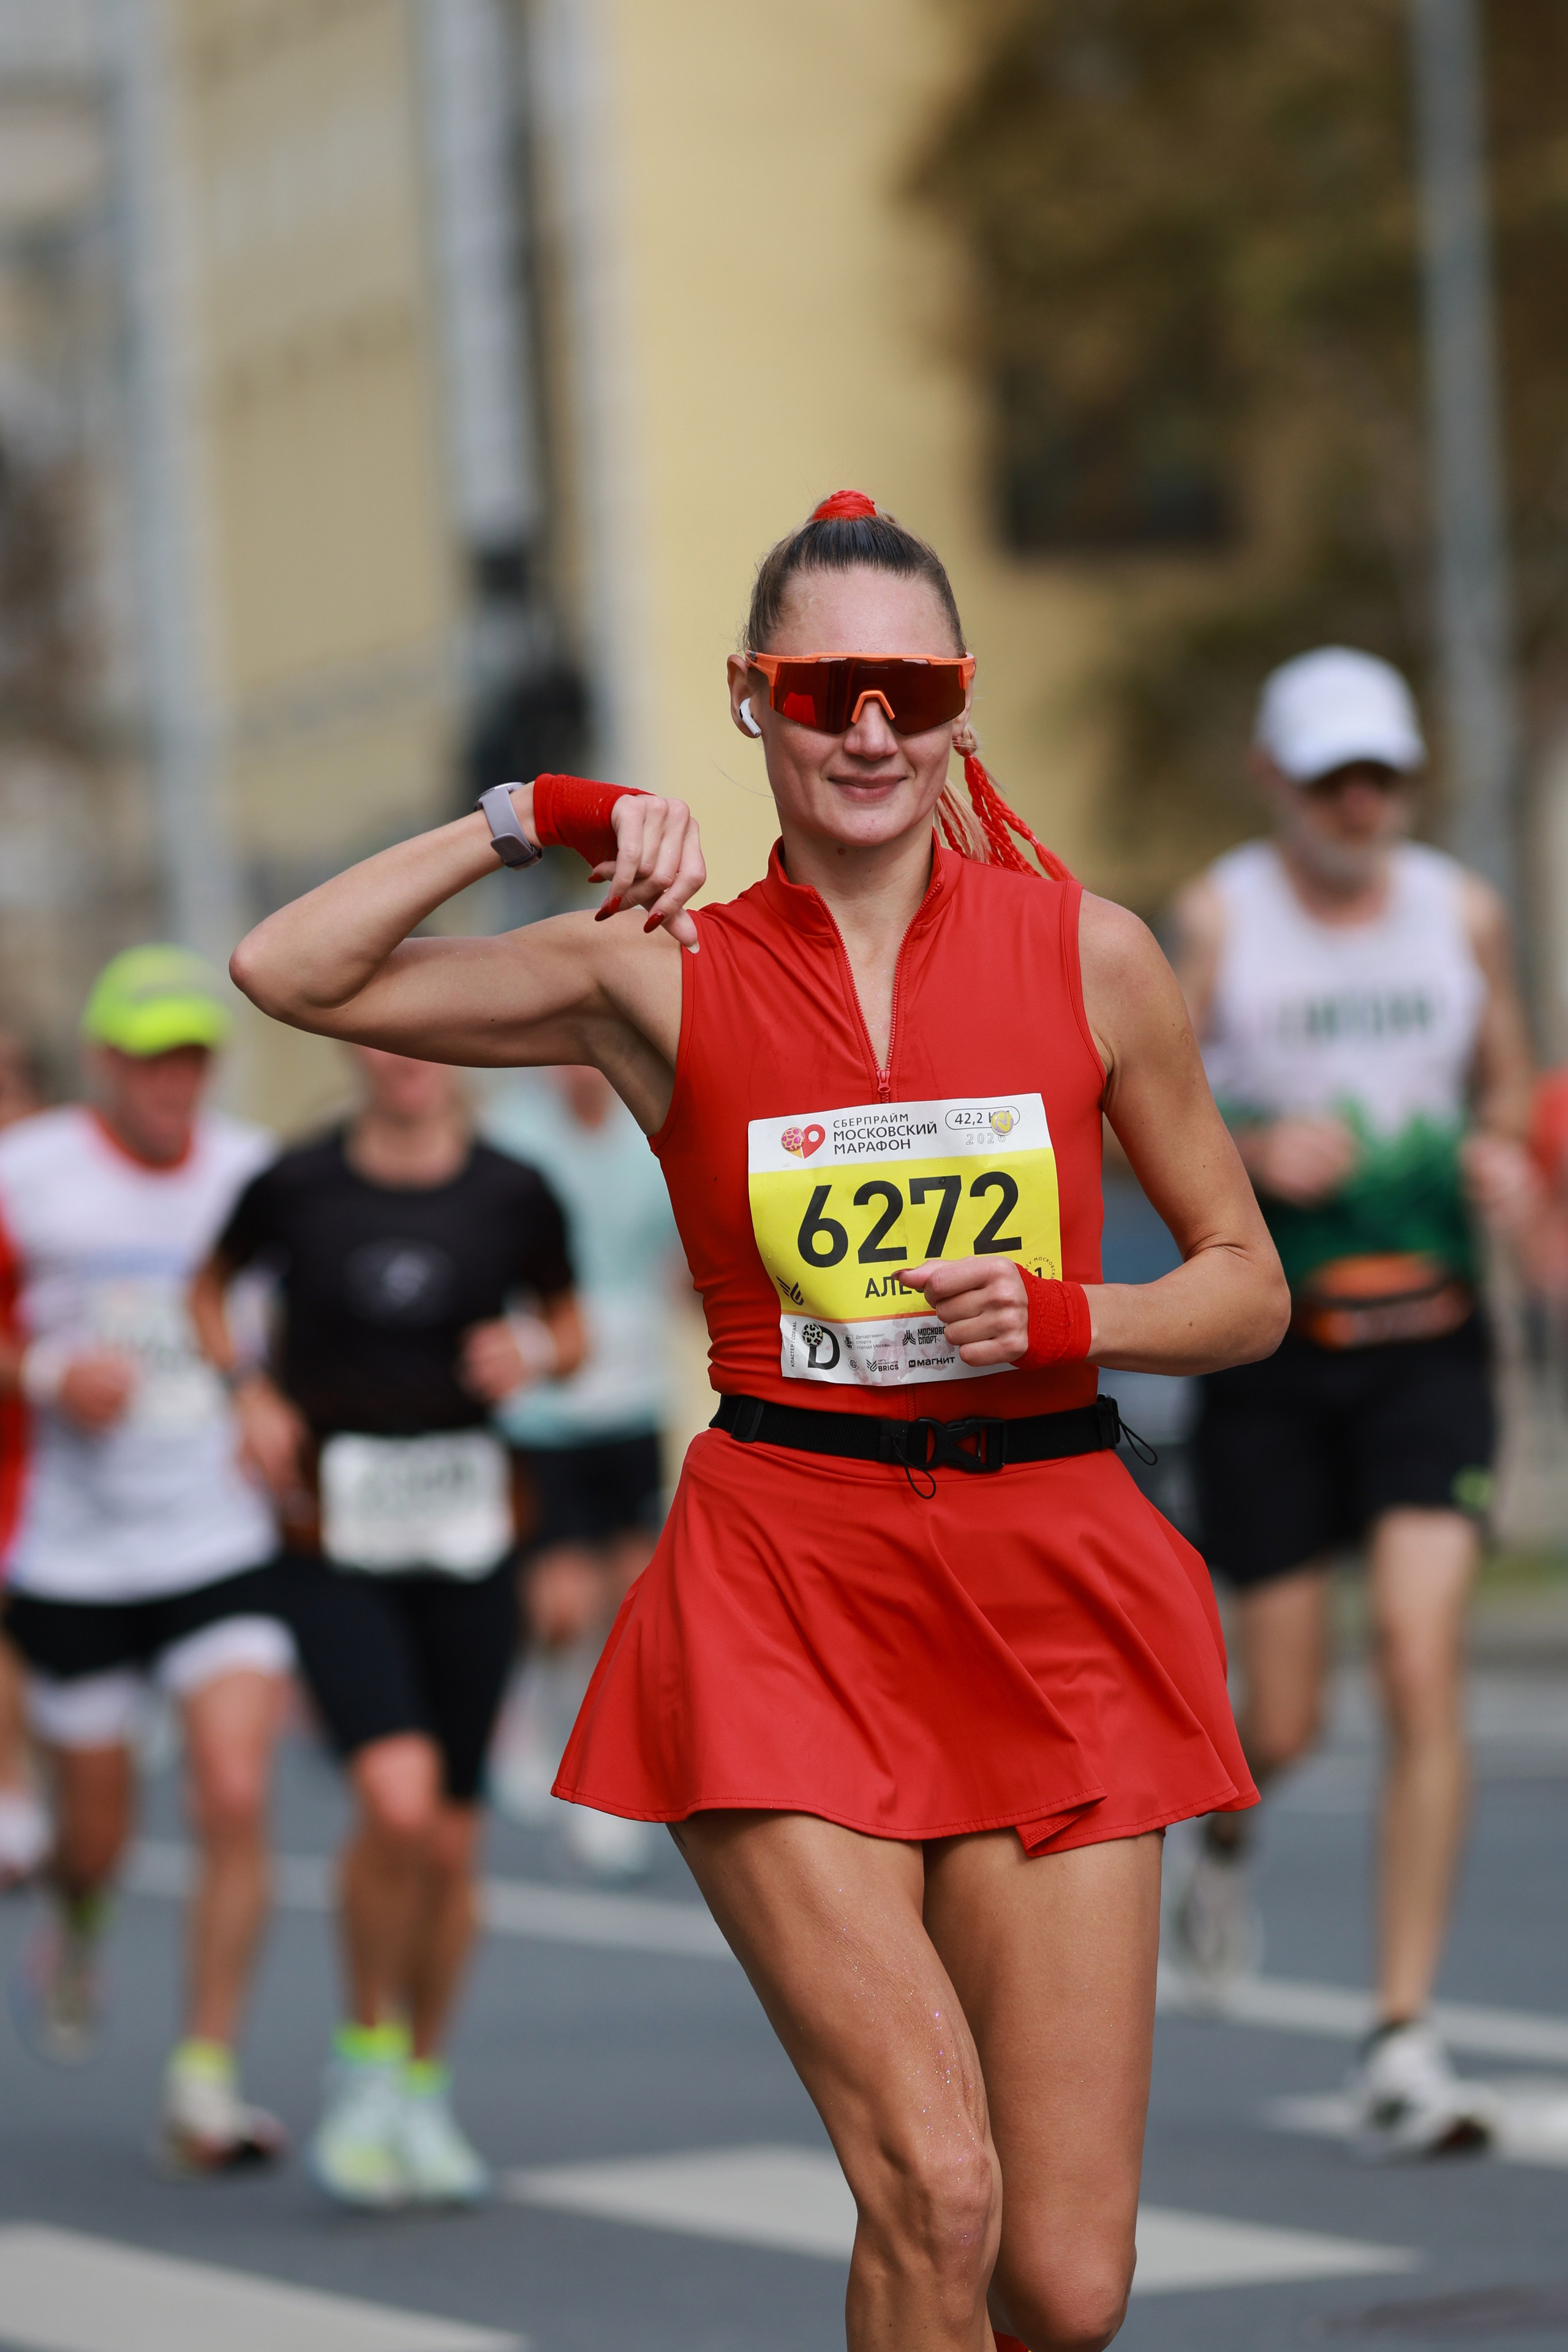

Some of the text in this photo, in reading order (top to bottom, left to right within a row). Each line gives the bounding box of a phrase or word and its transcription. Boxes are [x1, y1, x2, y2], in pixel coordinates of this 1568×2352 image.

[833, 1112, 909, 1128] СБЕРПРАЙМ
[954, 1112, 983, 1126] 42,2
[834, 1121, 938, 1142] МОСКОВСКИЙ
[834, 1139, 911, 1155] МАРАФОН
[797, 1170, 1022, 1268] 6272
[918, 1335, 937, 1344] СПОРТ
